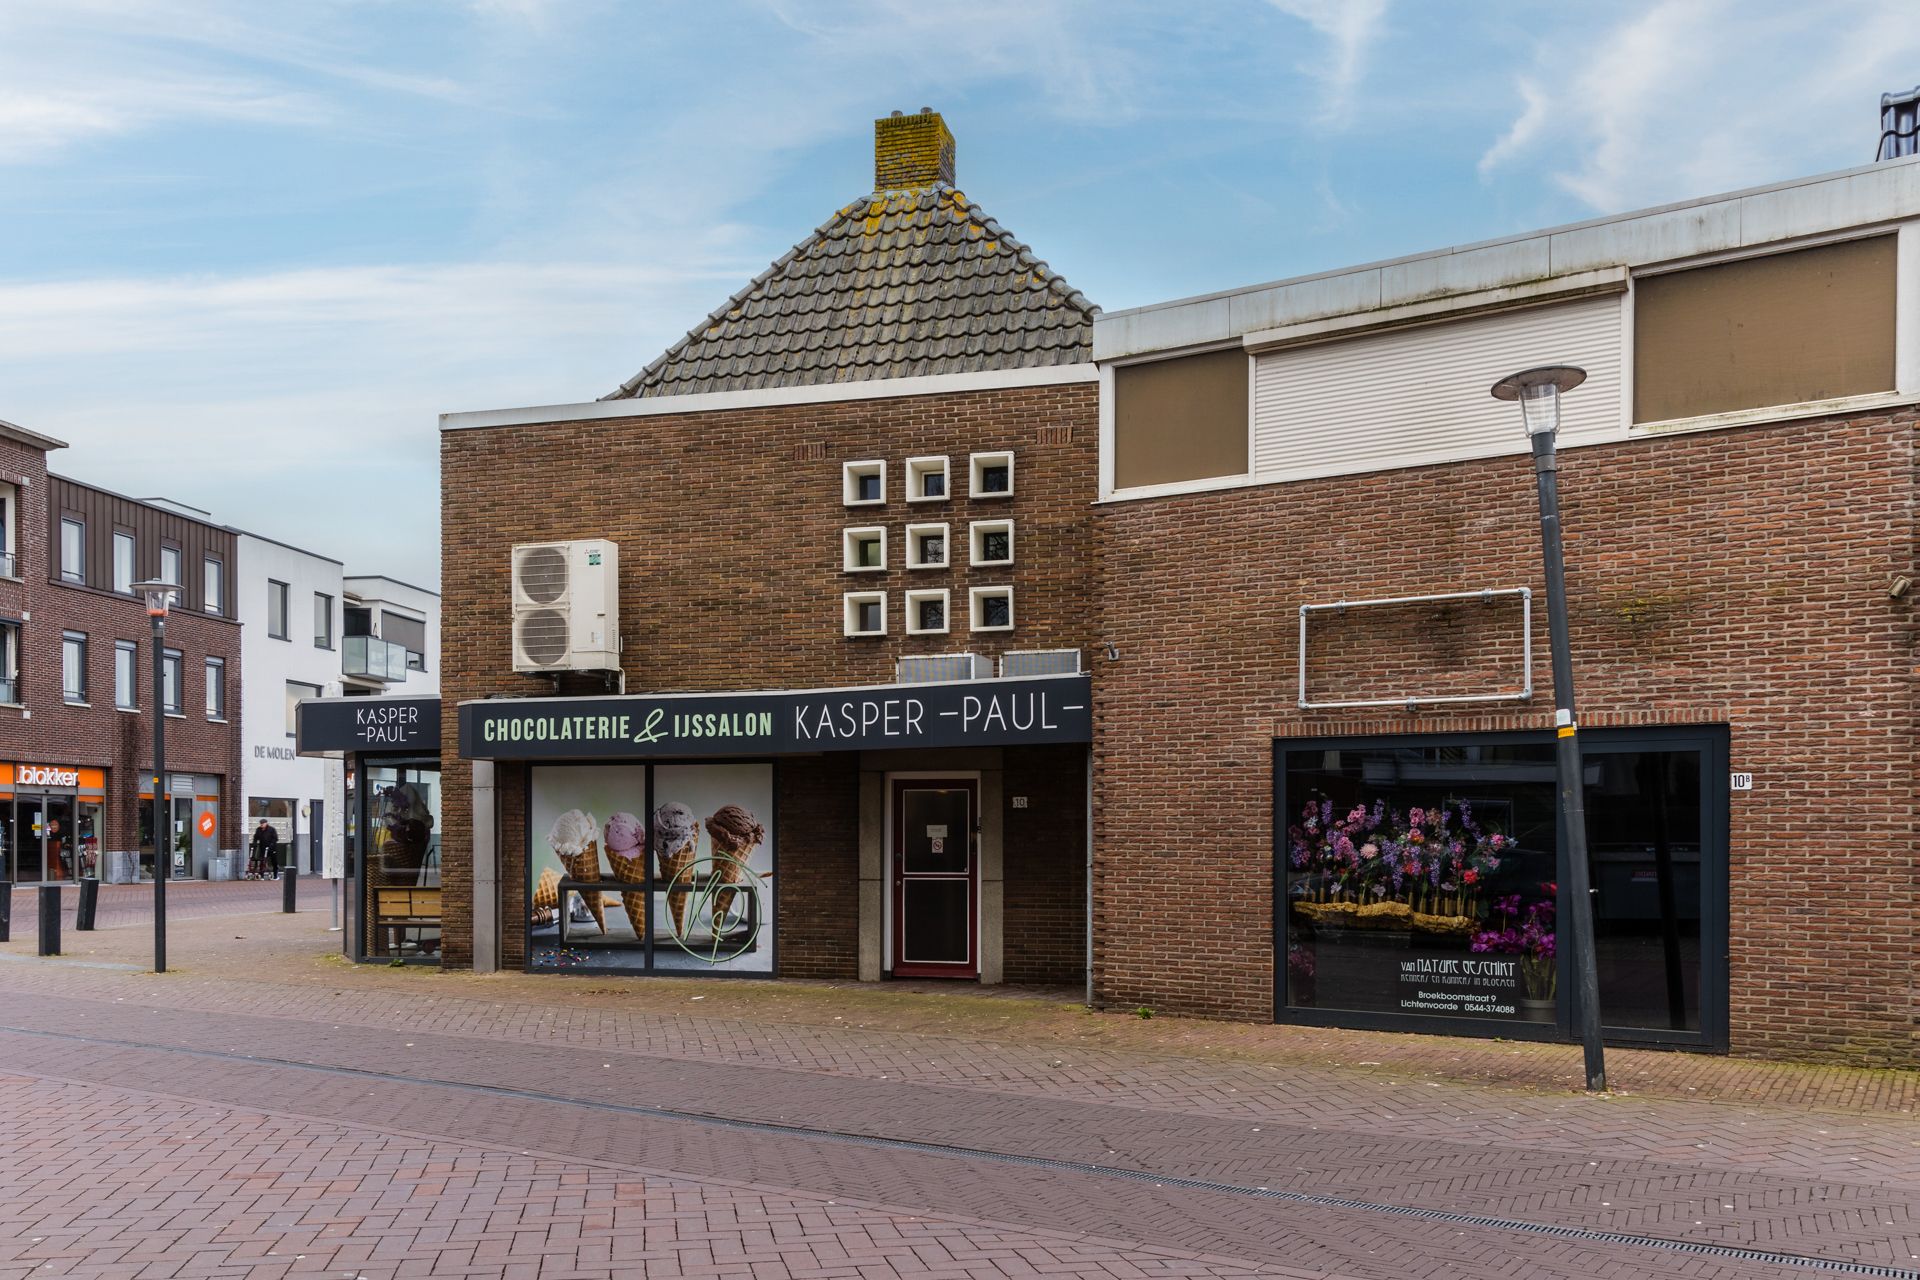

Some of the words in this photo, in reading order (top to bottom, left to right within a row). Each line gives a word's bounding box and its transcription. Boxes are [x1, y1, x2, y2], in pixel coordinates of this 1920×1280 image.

[357, 706, 418, 725] KASPER
[796, 699, 924, 739] KASPER
[484, 715, 630, 742] CHOCOLATERIE
[633, 708, 669, 743] &
[674, 712, 772, 739] IJSSALON
[254, 745, 265, 758] DE
[266, 746, 295, 760] MOLEN
[18, 766, 79, 786] blokker
[1417, 959, 1459, 973] NATURE
[1418, 991, 1490, 1003] Broekboomstraat
[1490, 995, 1497, 1003] 9
[1401, 1000, 1459, 1011] Lichtenvoorde
[1464, 1003, 1516, 1014] 0544-374088
